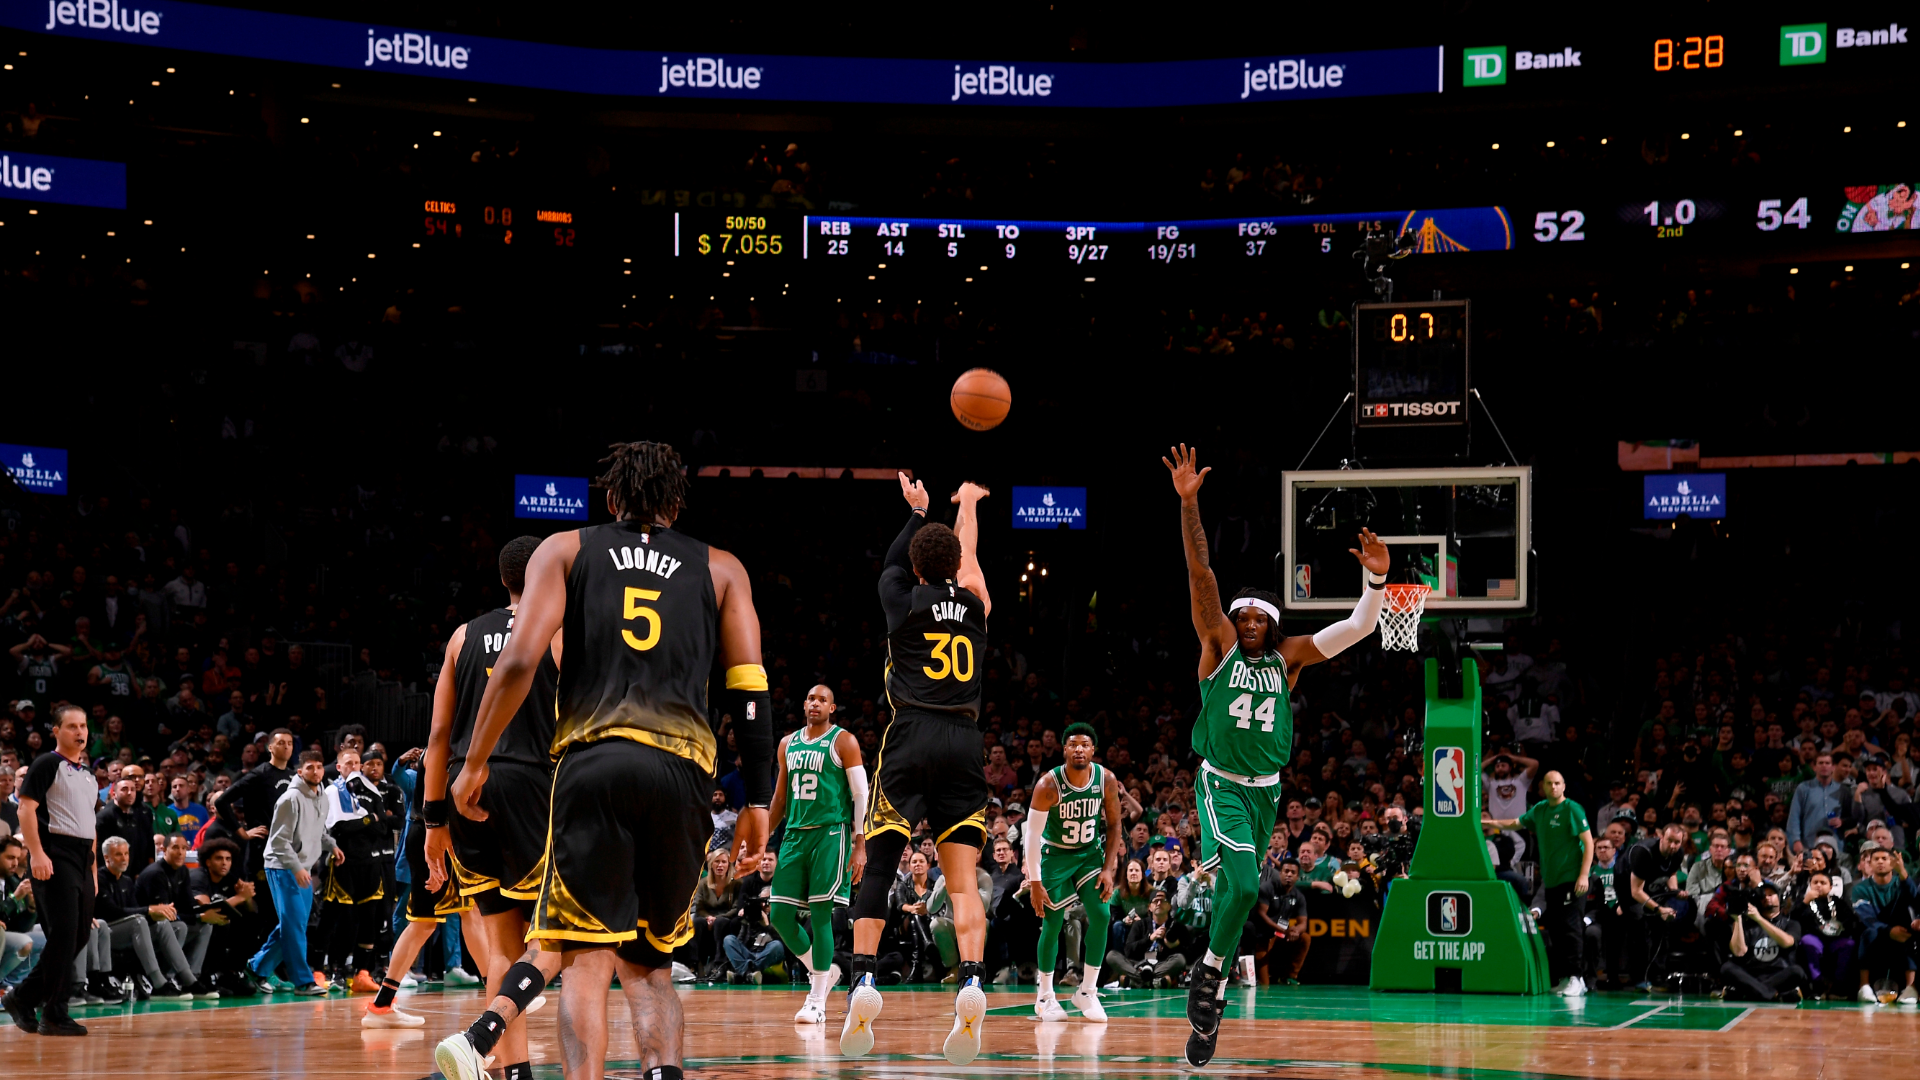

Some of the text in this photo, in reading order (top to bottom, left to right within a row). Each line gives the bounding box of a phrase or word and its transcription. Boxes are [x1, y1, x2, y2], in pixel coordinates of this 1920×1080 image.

[45, 0, 161, 35] jetBlue
[364, 28, 468, 70] jetBlue
[1653, 34, 1724, 72] 8:28
[1784, 23, 1908, 57] TD Bank
[658, 56, 761, 93] jetBlue
[1467, 47, 1582, 79] TD Bank
[951, 64, 1052, 101] jetBlue
[1240, 58, 1343, 99] jetBlue
[0, 155, 53, 191] lue
[424, 200, 456, 214] CELTICS
[1643, 199, 1696, 226] 1.0
[1757, 197, 1811, 231] 54
[725, 216, 766, 230] 50/50
[820, 220, 1382, 241] REB AST STL TO 3PT FG FG% TOL FLS
[1534, 210, 1585, 242] 52
[1653, 222, 1687, 238] 2nd
[698, 233, 711, 255] $
[828, 237, 1331, 264] 25 14 5 9 9/27 19/51 37 5
[1390, 312, 1434, 342] 0.7
[1389, 401, 1461, 417] TISSOT
[6, 466, 62, 481] BELLA
[519, 491, 583, 510] ARBELLA
[525, 506, 577, 516] INSURANCE
[1016, 503, 1081, 517] ARBELLA
[1648, 491, 1720, 508] ARBELLA
[1657, 505, 1711, 513] INSURANCE
[608, 546, 682, 580] LOONEY
[621, 586, 662, 652] 5
[931, 601, 968, 623] CURRY
[922, 632, 974, 683] 30
[110, 682, 131, 697] 36
[1228, 660, 1282, 694] BOSTON
[1228, 689, 1279, 733] 44
[786, 749, 826, 774] BOSTON
[790, 772, 819, 801] 42
[1059, 797, 1102, 820] BOSTON
[1437, 800, 1454, 814] NBA
[1061, 818, 1096, 845] 36
[1291, 918, 1371, 939] DEN
[1413, 940, 1485, 961] GET THE APP
